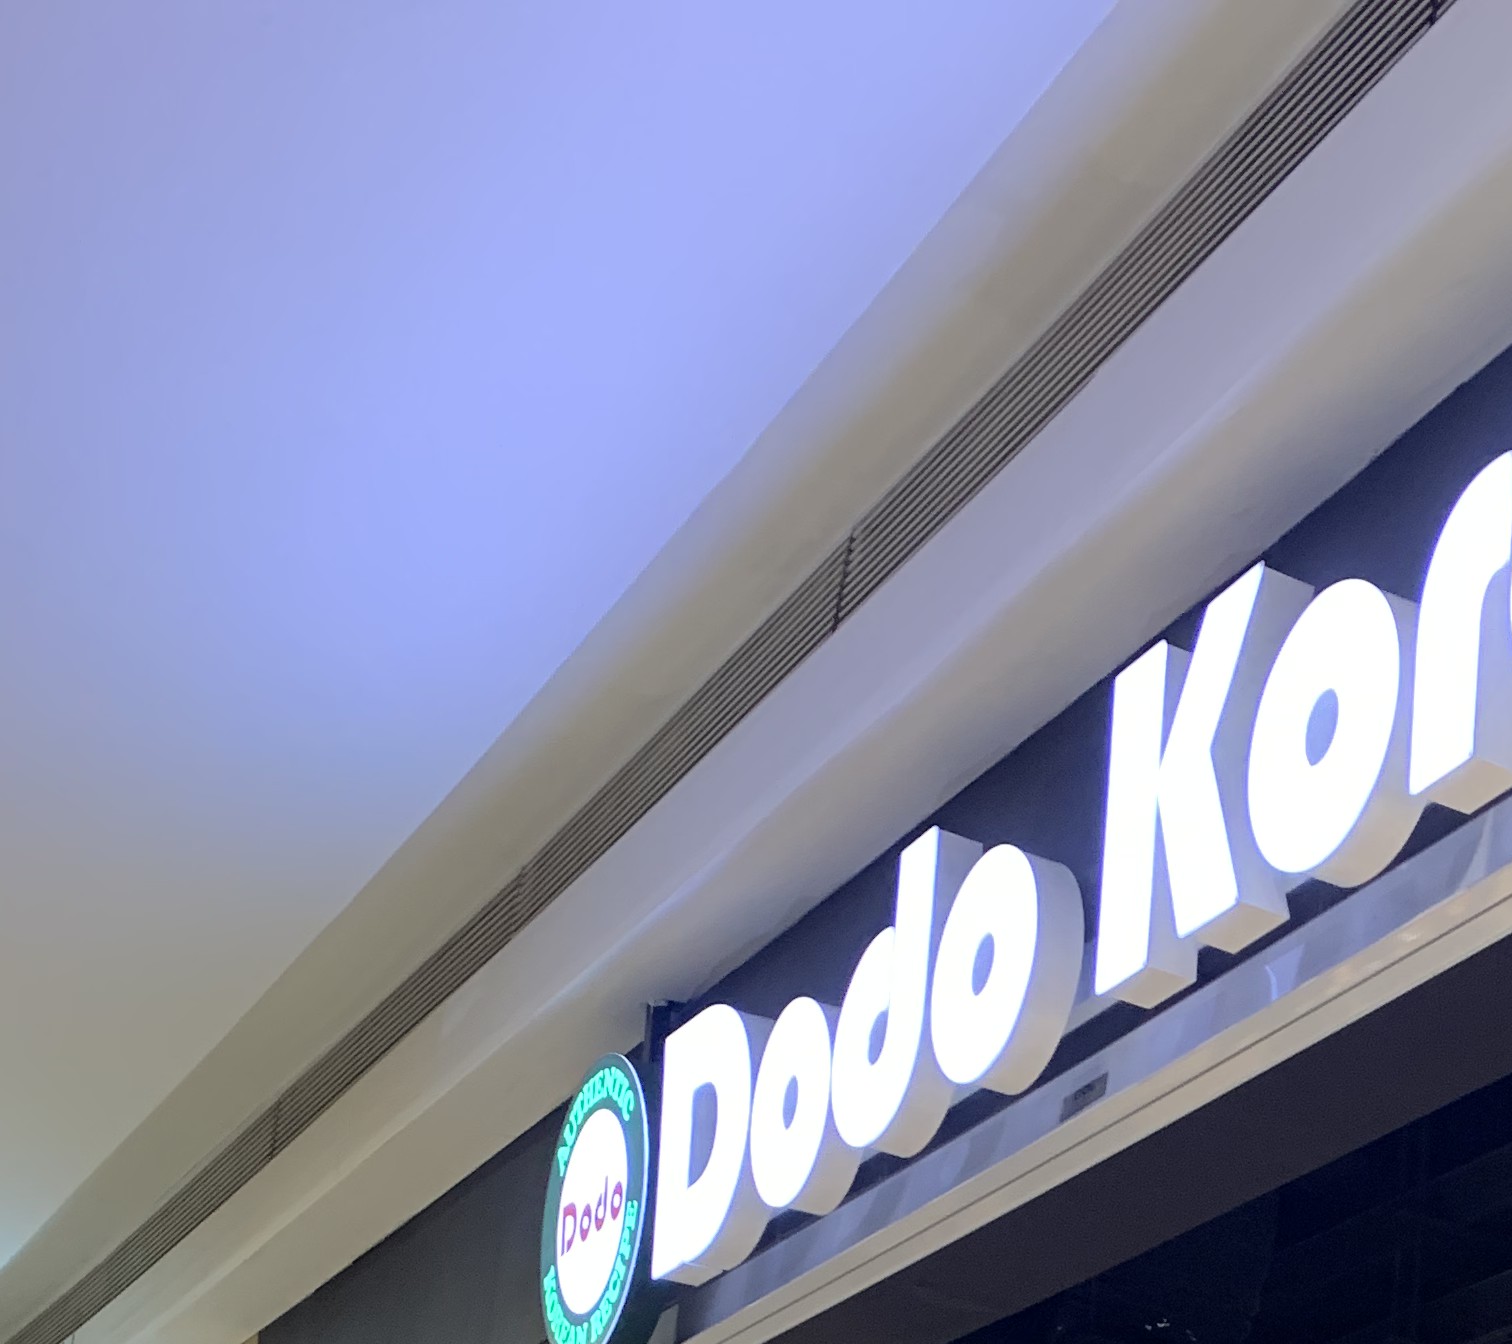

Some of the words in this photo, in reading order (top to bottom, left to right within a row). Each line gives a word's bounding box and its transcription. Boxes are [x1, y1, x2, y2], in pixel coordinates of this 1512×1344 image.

[651, 828, 1040, 1279] Dodo
[557, 1066, 635, 1177] AUTHENTIC
[561, 1175, 623, 1257] Dodo
[589, 1199, 639, 1344] RECIPE
